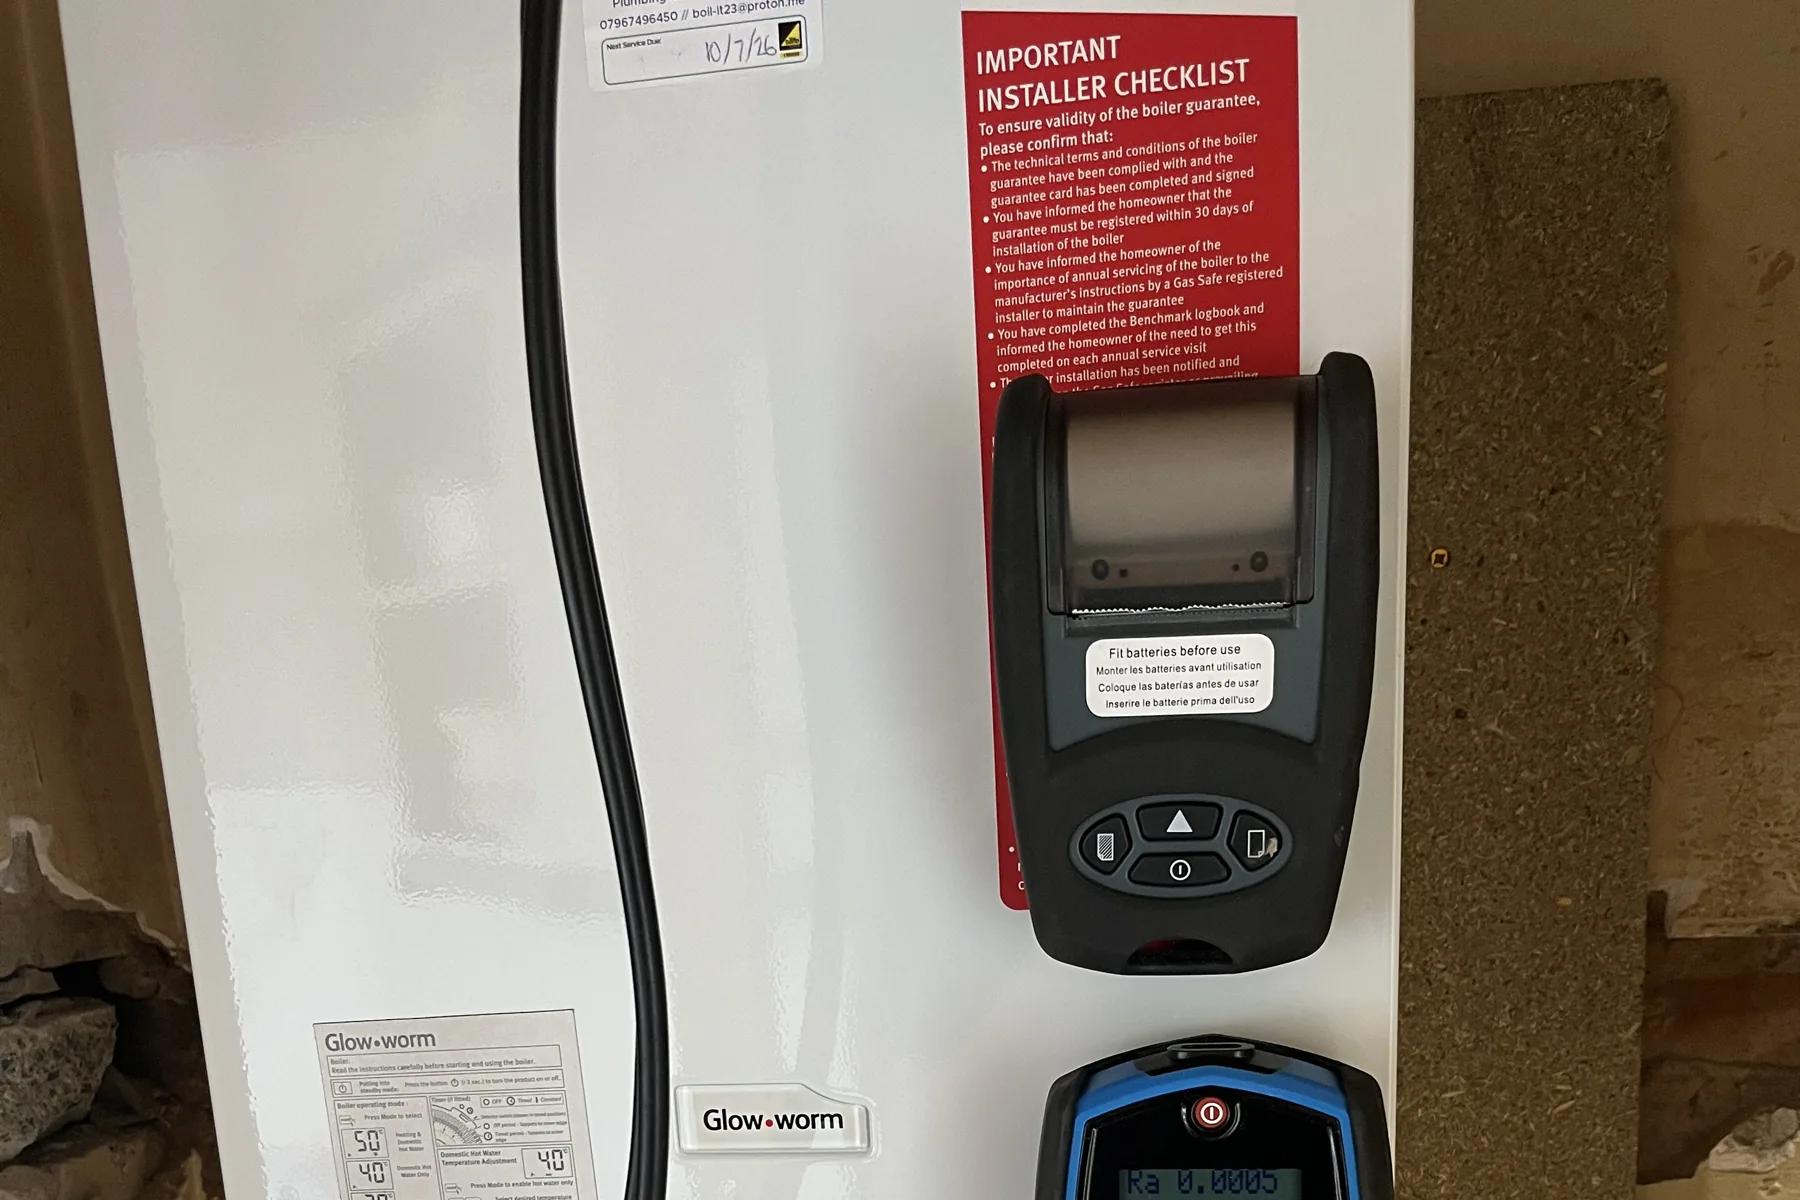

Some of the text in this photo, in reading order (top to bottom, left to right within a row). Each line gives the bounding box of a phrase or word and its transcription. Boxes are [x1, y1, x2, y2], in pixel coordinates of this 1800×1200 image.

[600, 11, 678, 30] 07967496450
[623, 39, 646, 49] Service
[977, 35, 1121, 75] IMPORTANT
[978, 58, 1249, 112] INSTALLER CHECKLIST
[978, 94, 1260, 136] To ensure validity of the boiler guarantee,
[980, 129, 1113, 160] please confirm that:
[991, 132, 1257, 172] The technical terms and conditions of the boiler
[990, 165, 1254, 209] guarantee card has been completed and signed
[991, 199, 1253, 243] guarantee must be registered within 30 days of
[993, 251, 1269, 292] importance of annual servicing of the boiler to the
[1079, 282, 1145, 298] instructions
[1147, 279, 1161, 293] by
[1163, 280, 1170, 289] a
[1173, 276, 1194, 288] Gas
[1197, 272, 1222, 286] Safe
[1225, 265, 1283, 284] registered
[995, 295, 1184, 323] installer to maintain the guarantee
[997, 301, 1264, 340] You have completed the Benchmark logbook and
[997, 341, 1206, 373] completed on each annual service visit
[1056, 367, 1117, 383] installation
[1120, 365, 1140, 377] has
[1142, 363, 1169, 375] been
[1173, 356, 1216, 372] notified
[1218, 354, 1239, 368] and
[1109, 644, 1241, 659] Fit batteries before use
[1095, 661, 1262, 675] Monter les batteries avant utilisation
[1097, 682, 1137, 693] Coloque
[1138, 682, 1153, 691] las
[1195, 679, 1222, 689] antes
[1223, 678, 1236, 688] de
[1238, 679, 1259, 688] usar
[1105, 700, 1140, 708] Inserire
[1142, 698, 1151, 707] le
[1152, 698, 1188, 707] batterie
[1190, 697, 1217, 707] prima
[1178, 1170, 1278, 1194] 0.0005
